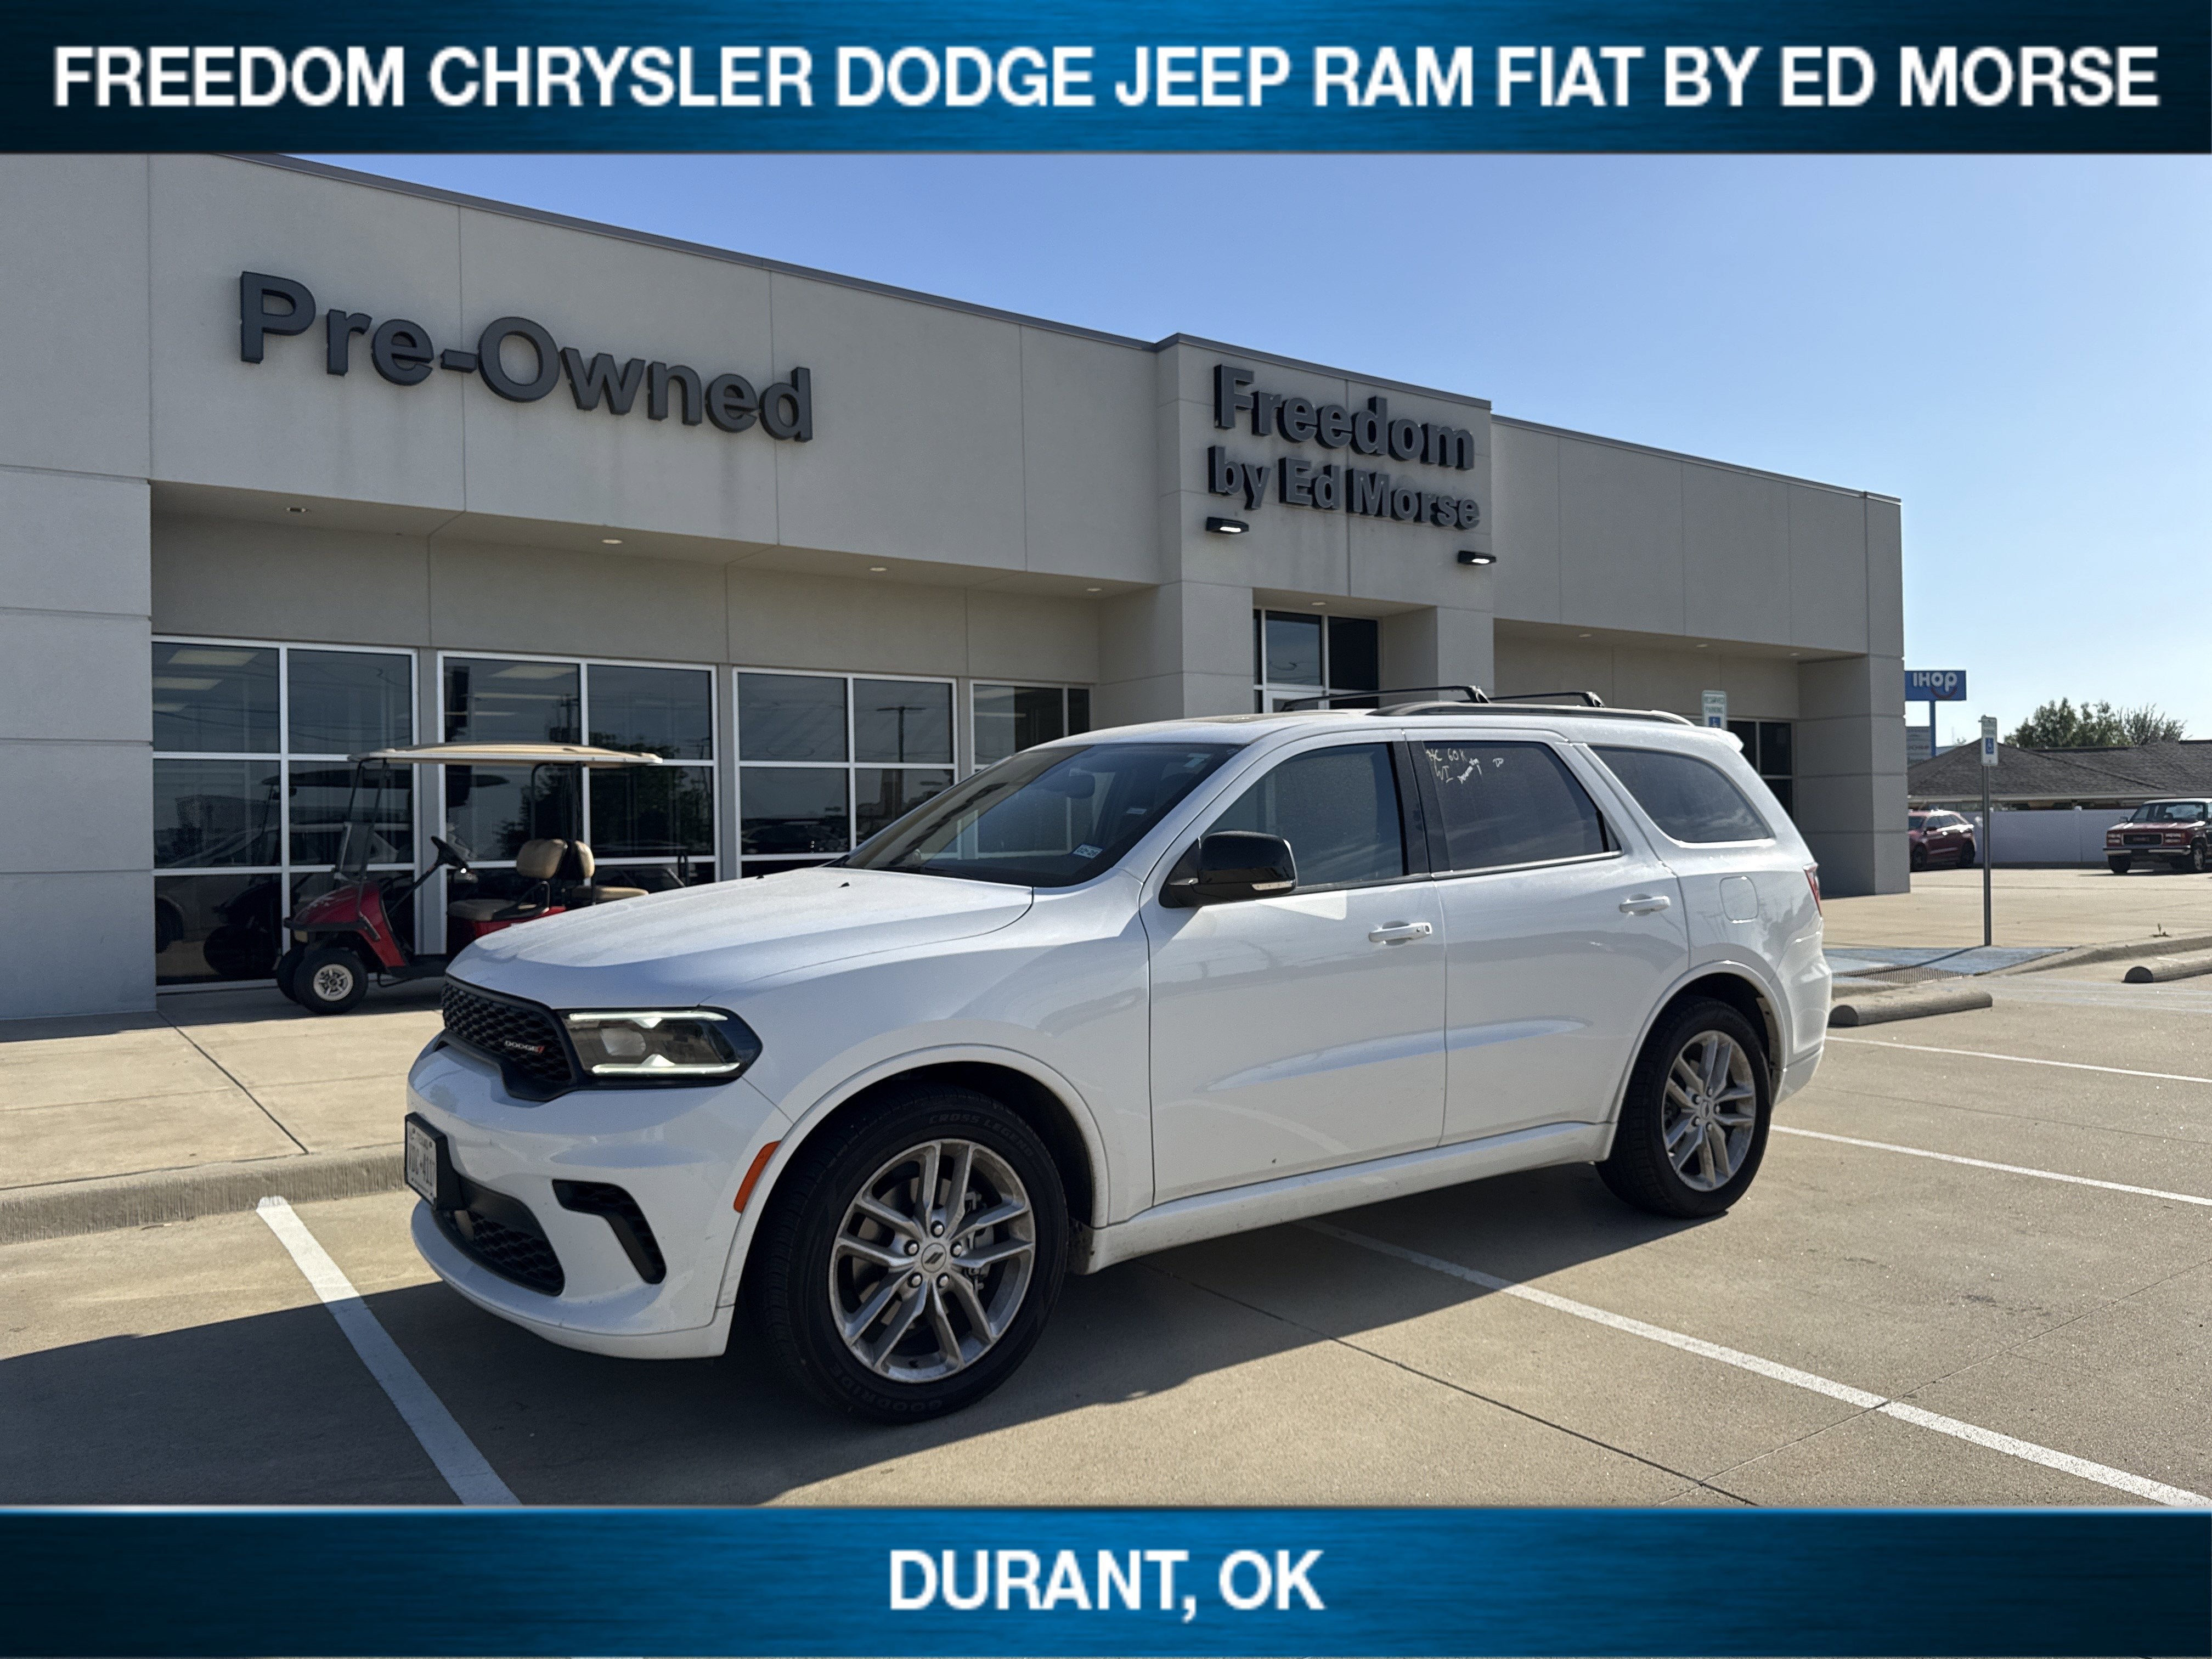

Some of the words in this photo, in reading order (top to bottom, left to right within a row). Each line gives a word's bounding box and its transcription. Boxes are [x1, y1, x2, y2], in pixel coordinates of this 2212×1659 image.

[240, 270, 814, 442] Pre-Owned
[1214, 364, 1475, 471] Freedom
[1207, 445, 1271, 511] by
[1278, 456, 1341, 510] Ed
[1346, 467, 1481, 531] Morse
